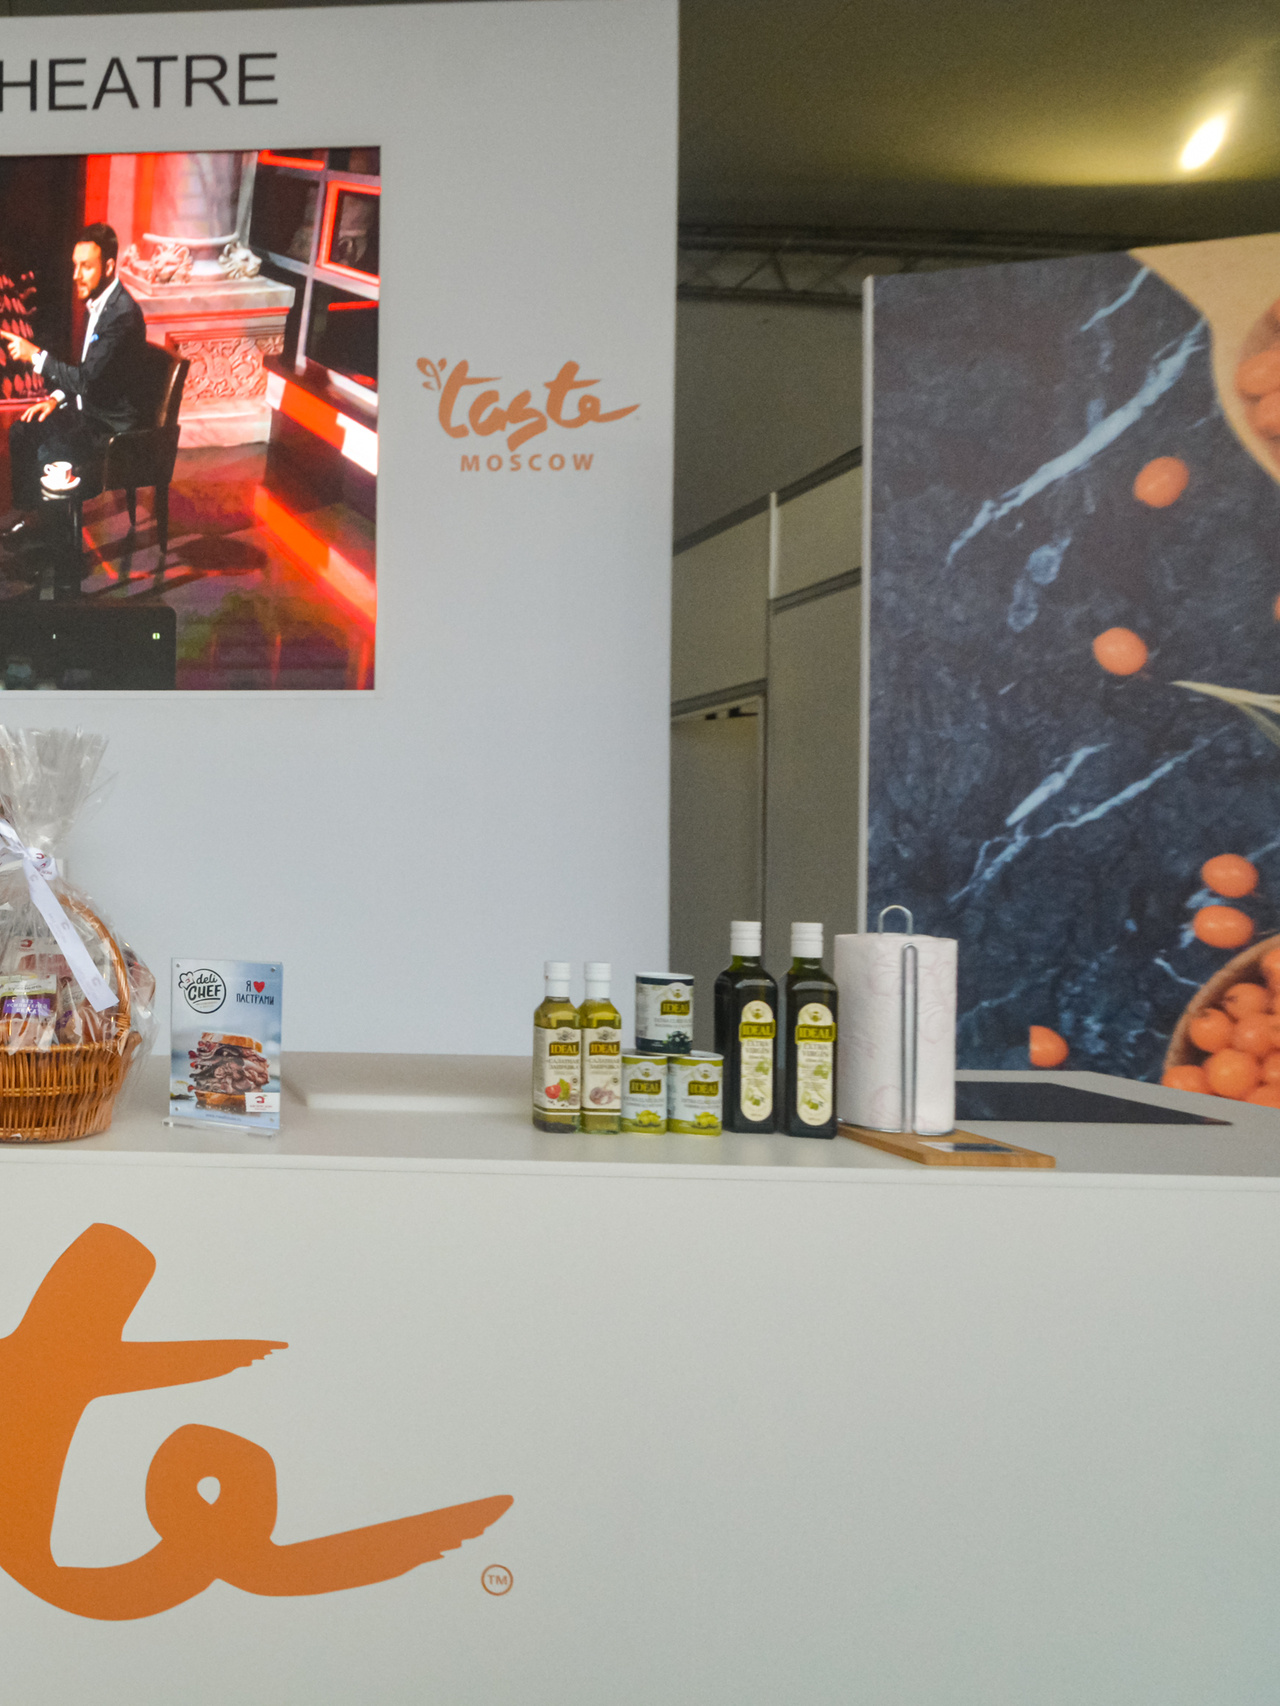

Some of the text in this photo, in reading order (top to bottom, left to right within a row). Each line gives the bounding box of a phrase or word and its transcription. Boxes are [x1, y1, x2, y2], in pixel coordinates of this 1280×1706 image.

[460, 453, 594, 472] MOSCOW
[196, 973, 218, 984] deli
[188, 984, 222, 1000] CHEF
[236, 993, 275, 1005] ПАСТРАМИ
[662, 1002, 690, 1013] IDEAL
[742, 1026, 772, 1036] IDEAL
[800, 1029, 832, 1038] IDEAL
[550, 1044, 578, 1054] IDEAL
[590, 1044, 619, 1054] IDEAL
[631, 1082, 660, 1092] IDEAL
[690, 1084, 718, 1094] IDEAL
